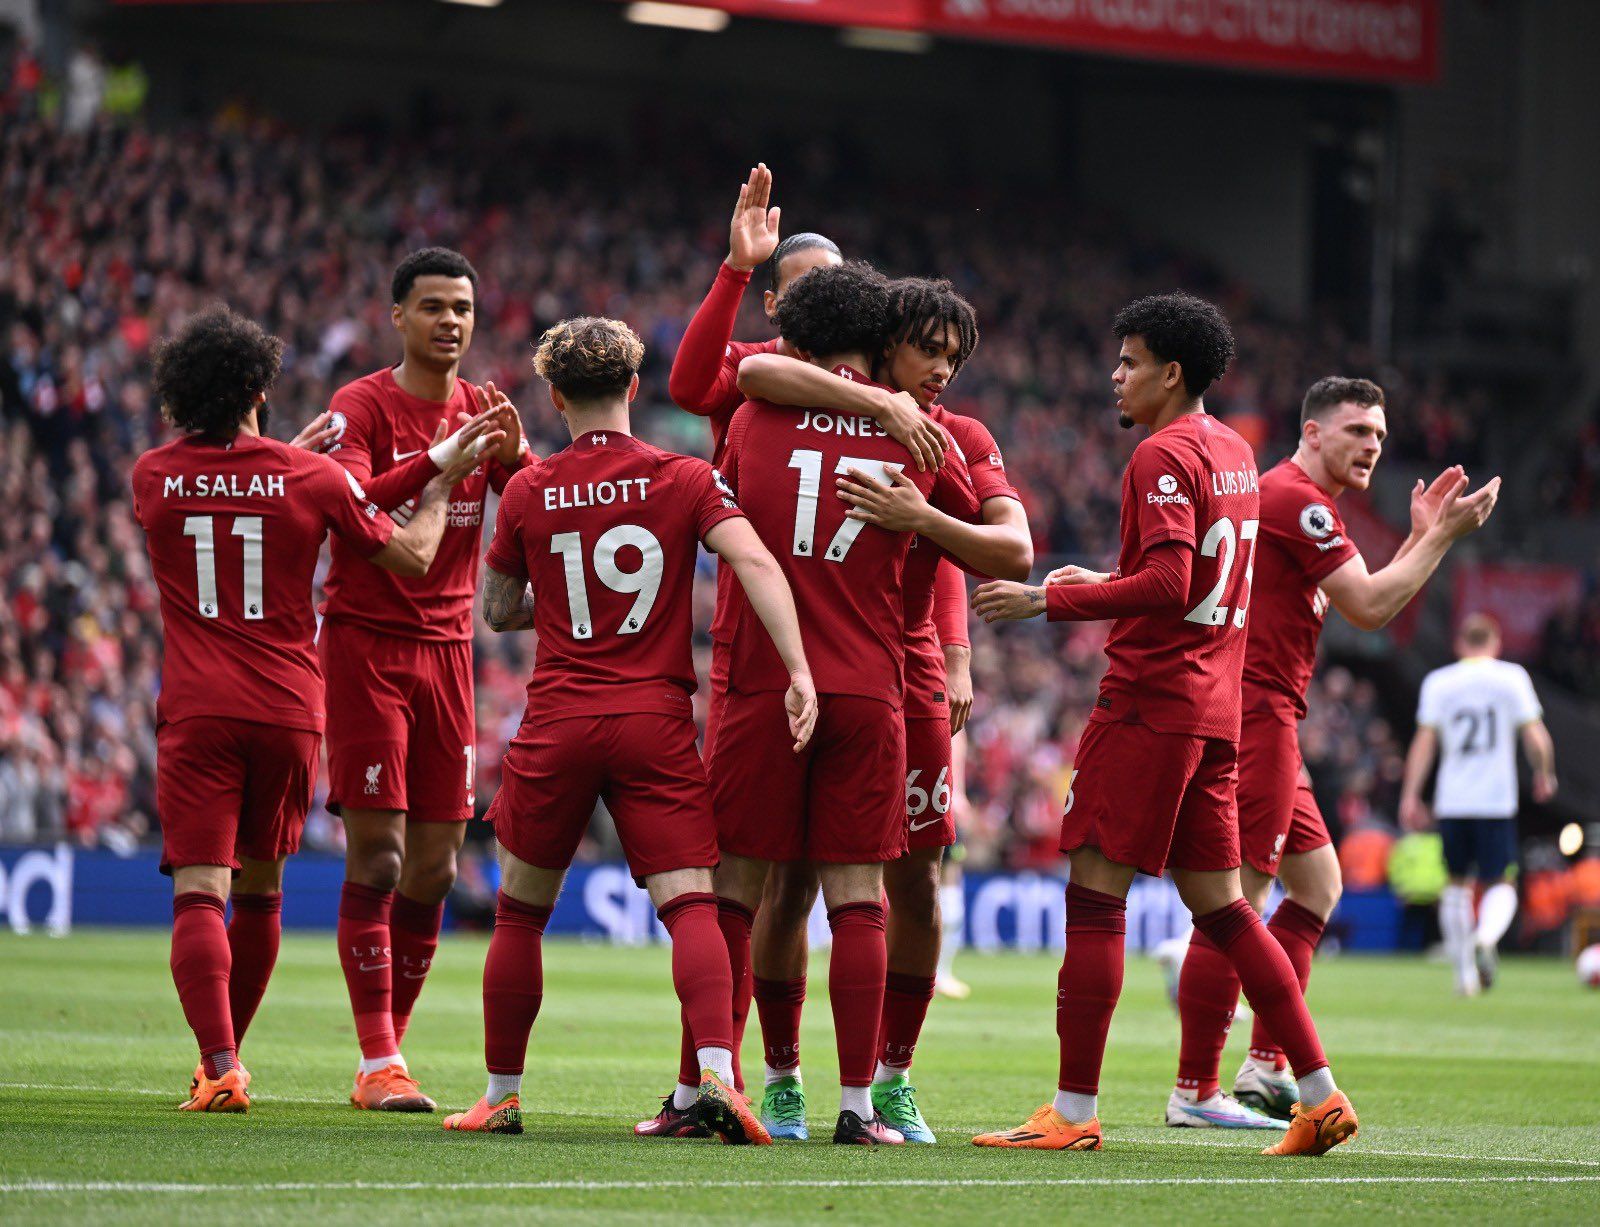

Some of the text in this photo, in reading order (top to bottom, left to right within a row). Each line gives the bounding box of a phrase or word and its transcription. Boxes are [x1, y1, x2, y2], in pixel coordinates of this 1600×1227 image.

[796, 411, 888, 437] JONES
[544, 477, 651, 511] ELLIOTT
[1147, 492, 1189, 507] Expedia
[1212, 461, 1259, 496] LUIS DÍA
[787, 449, 905, 563] 17
[183, 515, 264, 620] 11
[550, 524, 665, 640] 19
[1453, 706, 1497, 755] 21
[906, 766, 951, 816] 66
